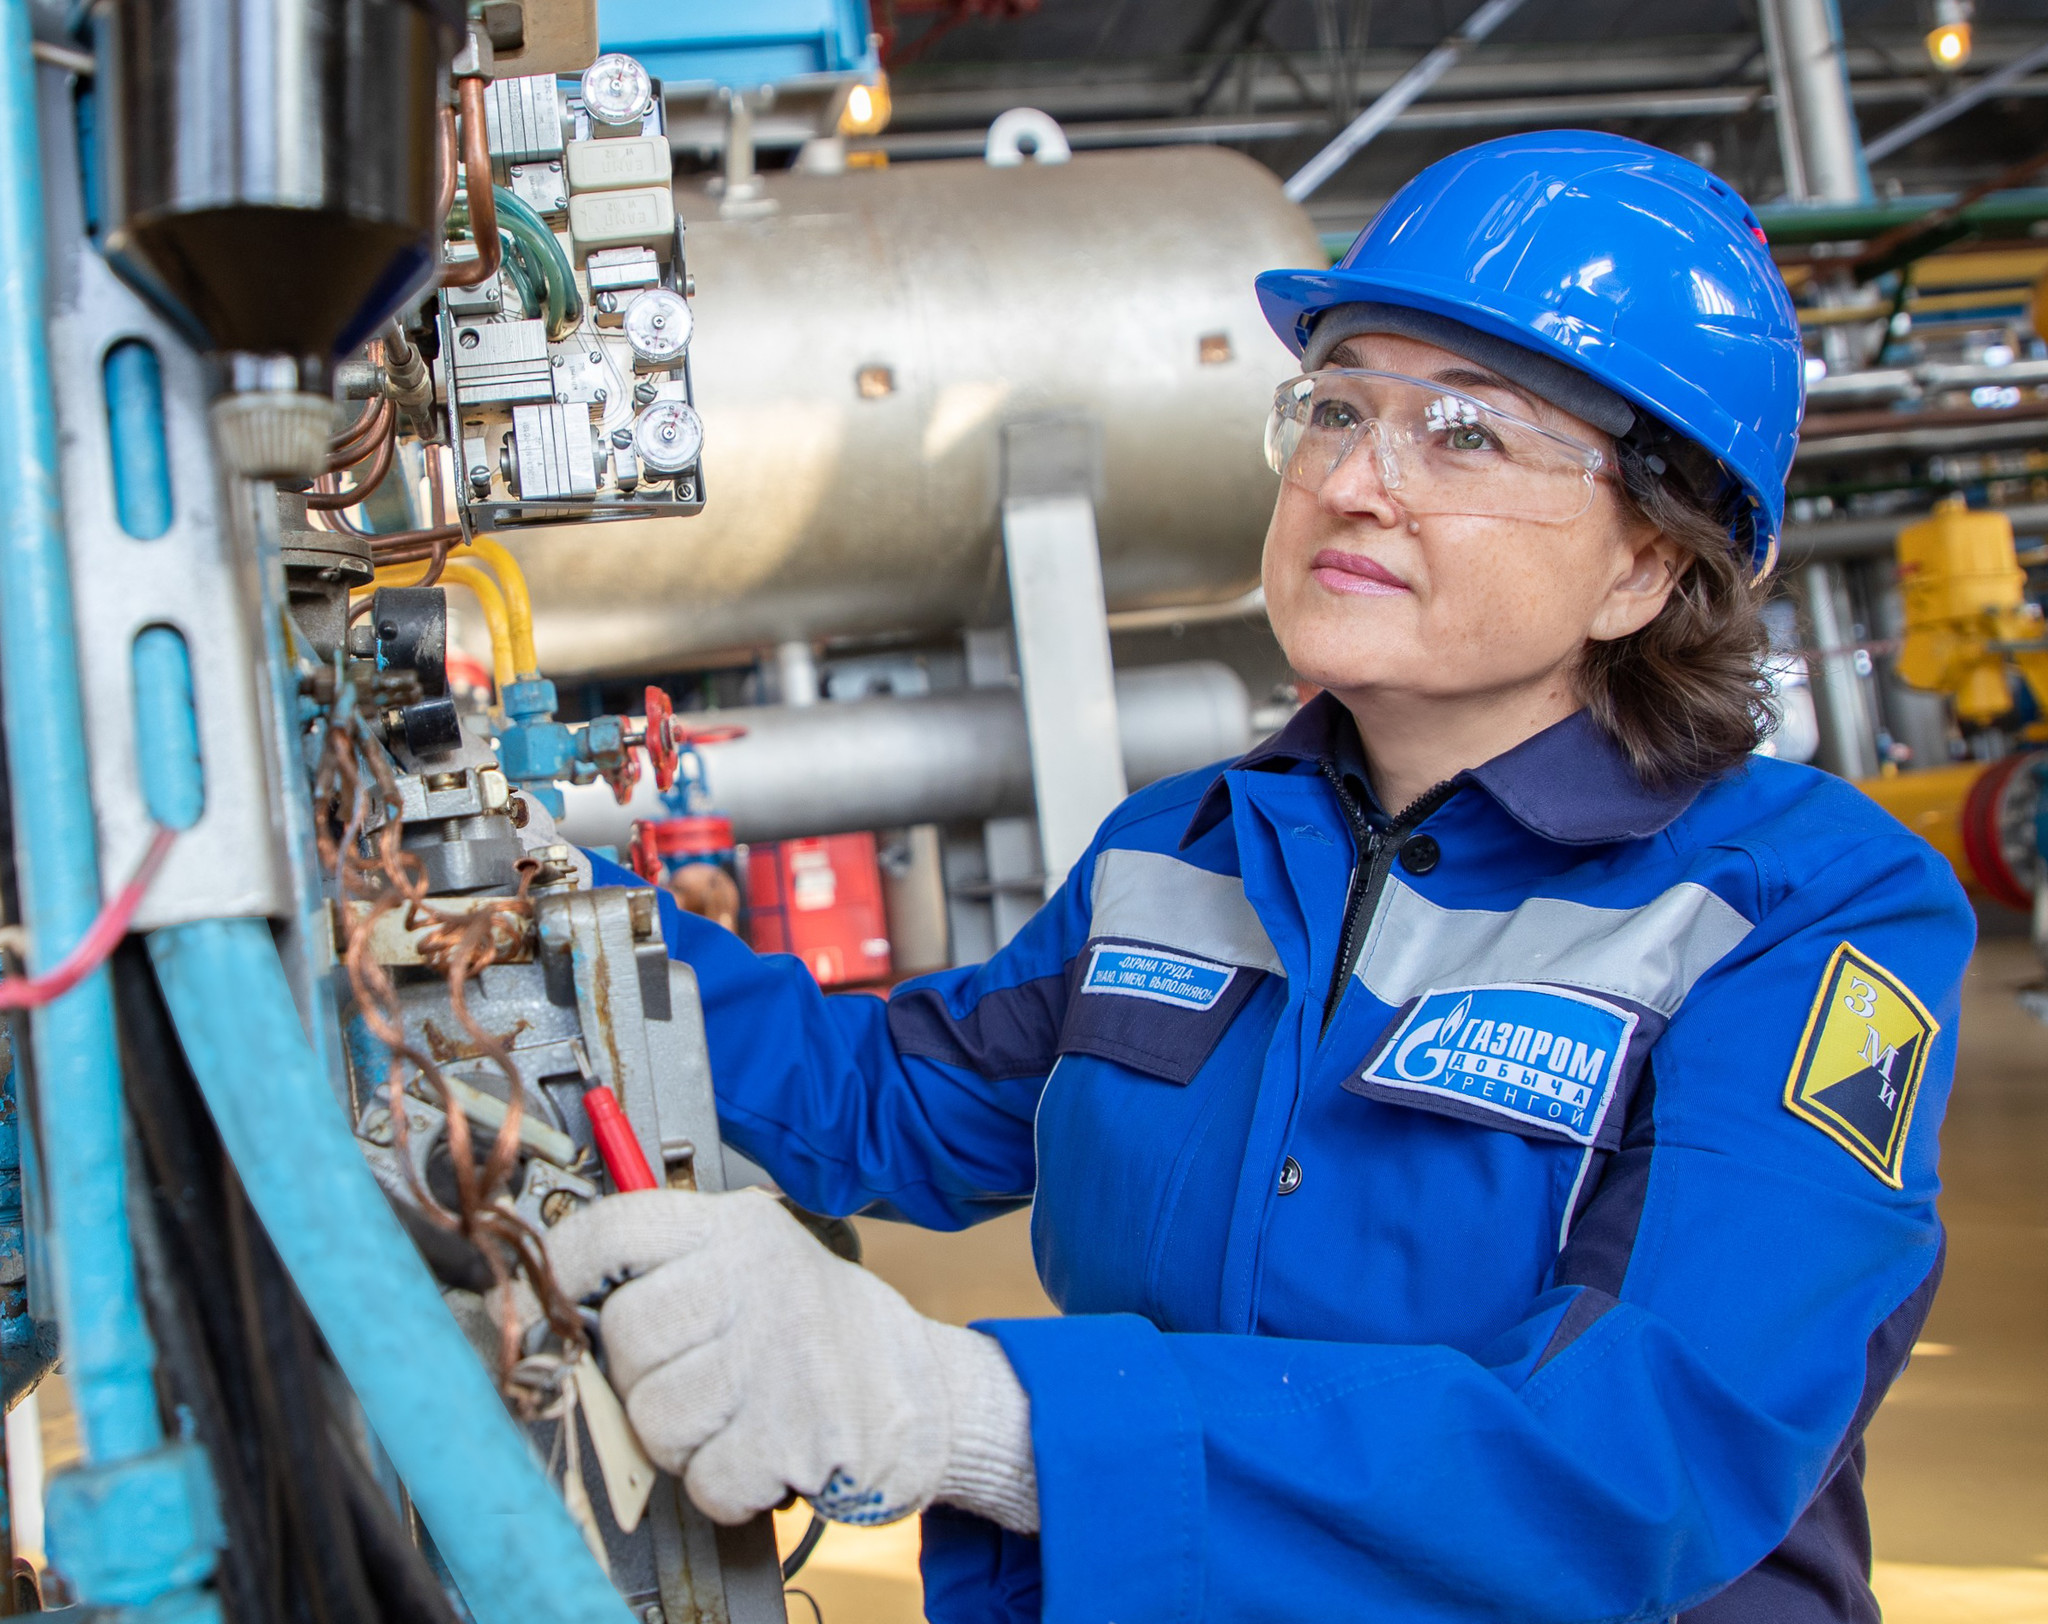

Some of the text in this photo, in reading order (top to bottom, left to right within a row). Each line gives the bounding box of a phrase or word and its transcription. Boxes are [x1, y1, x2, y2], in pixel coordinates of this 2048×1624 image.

[1117, 971, 1146, 988] УМЕЮ,
[1457, 1018, 1607, 1085] ГАЗПРОМ
[1443, 1071, 1585, 1127] УРЕНГОЙ
[1452, 1053, 1586, 1105] ДОБЫЧА
